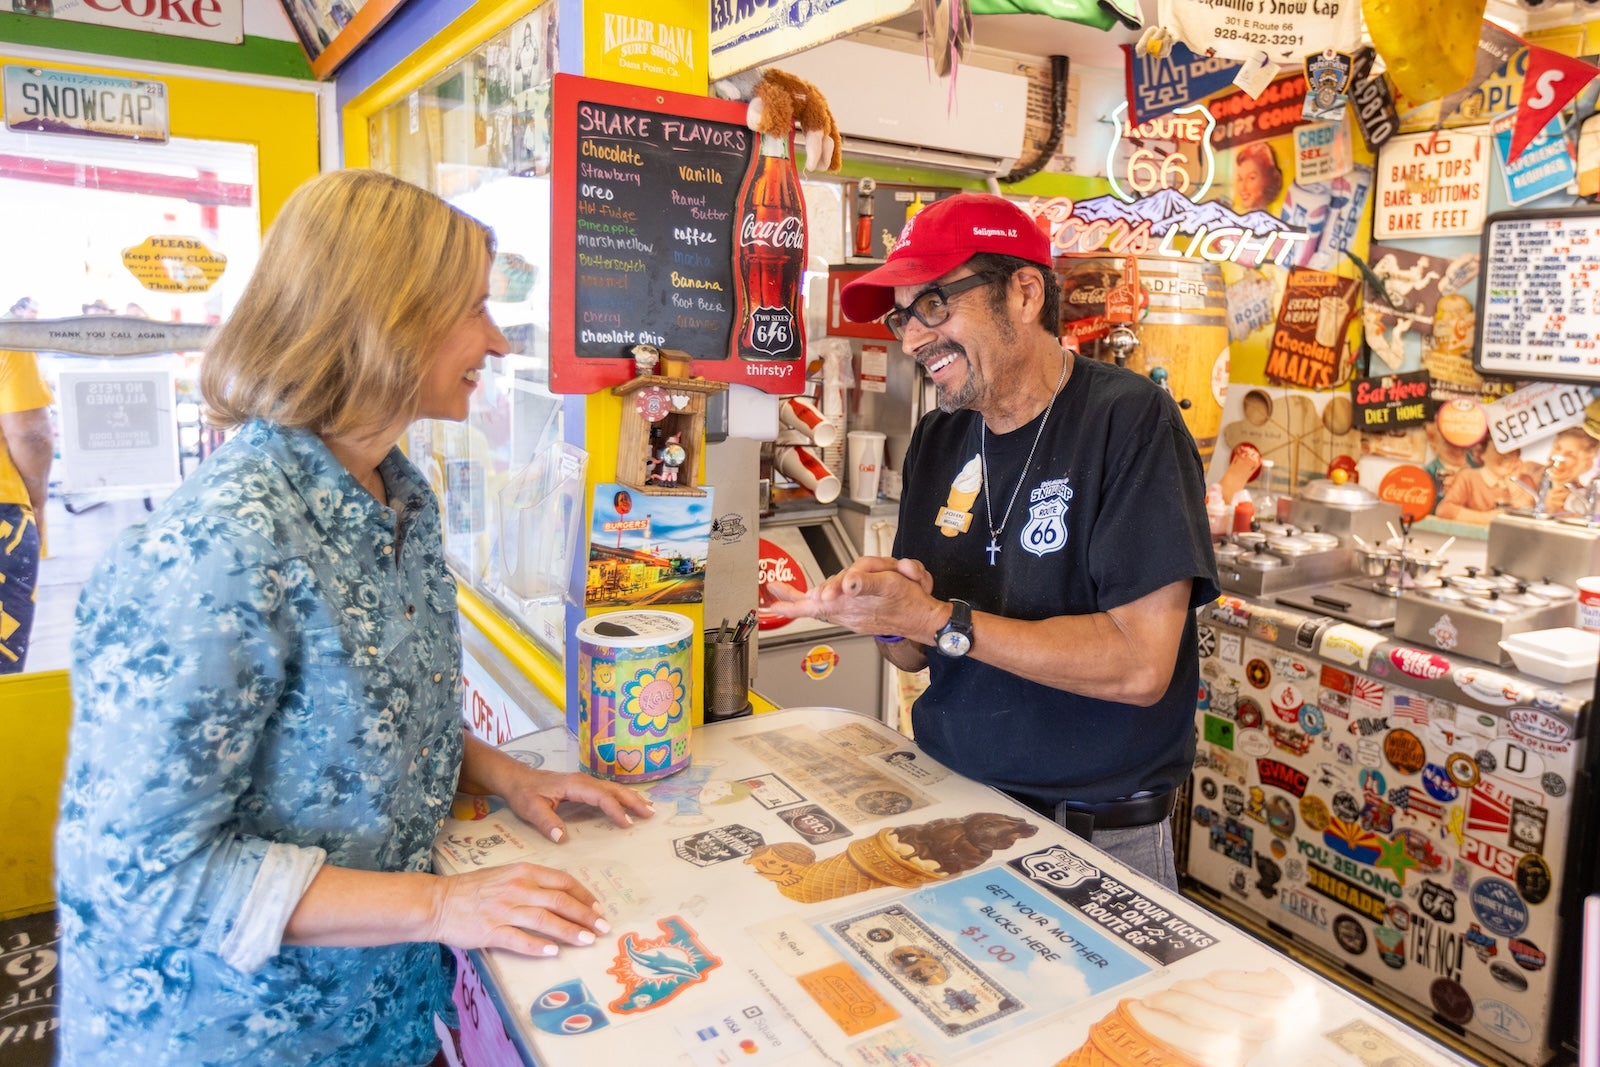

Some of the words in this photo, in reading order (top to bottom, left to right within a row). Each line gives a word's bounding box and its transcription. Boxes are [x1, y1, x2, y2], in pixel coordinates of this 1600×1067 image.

[82, 0, 222, 27] oke
[1225, 16, 1241, 26] 301
[1252, 19, 1280, 31] Route
[1281, 23, 1294, 32] 66
[604, 13, 654, 55] KILLER
[658, 24, 694, 70] DANA
[1214, 27, 1304, 46] 928-422-3291
[618, 58, 641, 70] Dana
[621, 43, 649, 58] SURF
[650, 44, 679, 65] SHOP
[22, 83, 152, 125] SNOWCAP
[580, 106, 651, 137] SHAKE
[661, 121, 746, 151] FLAVORS
[1414, 140, 1451, 157] NO
[581, 162, 641, 186] Strawberry
[1127, 149, 1190, 194] 66
[1391, 163, 1425, 183] BARE
[1436, 159, 1472, 177] TOPS
[671, 189, 707, 207] Peanut
[1384, 187, 1414, 208] BARE
[1421, 183, 1480, 205] BOTTOMS
[690, 207, 729, 221] Butter
[1388, 212, 1423, 231] BARE
[1432, 210, 1468, 229] FEET
[739, 213, 804, 250] Coca-Cola
[1008, 229, 1018, 238] AZ
[152, 238, 201, 250] PLEASE
[1159, 224, 1310, 266] LIGHT
[125, 252, 151, 262] Keep
[578, 252, 648, 273] Butterscotch
[149, 282, 183, 291] Thank
[186, 284, 208, 292] you!
[671, 271, 724, 292] Banana
[1169, 281, 1207, 296] HERE
[672, 293, 694, 309] Root
[1069, 287, 1108, 304] Coca-Col
[771, 314, 789, 322] SIXES
[110, 331, 132, 339] CALL
[1275, 330, 1336, 364] Chocolate
[746, 364, 794, 377] thirsty?
[1266, 349, 1334, 387] MALTS
[1357, 382, 1388, 405] Eat
[1389, 380, 1427, 400] Here
[1365, 407, 1389, 425] DIET
[1397, 404, 1425, 421] HOME
[944, 511, 964, 519] JOHN
[1039, 505, 1057, 516] ROUTE
[604, 519, 647, 530] BURGERS
[1031, 519, 1057, 545] 66
[1396, 648, 1431, 663] road
[1402, 658, 1445, 678] sister
[801, 814, 829, 834] 1313
[1055, 861, 1070, 871] US
[1058, 853, 1090, 874] ROUTE
[1295, 836, 1328, 865] YOU
[1333, 855, 1403, 898] BELONG
[1461, 838, 1516, 876] PUS
[1033, 861, 1069, 882] 66
[985, 884, 1014, 902] GET
[1012, 900, 1049, 927] YOUR
[1049, 927, 1109, 969] MOTHER
[1080, 902, 1125, 935] ROUTE
[1125, 909, 1149, 927] ON
[1128, 894, 1168, 923] YOUR
[1163, 917, 1213, 948] KICKS
[960, 925, 1016, 963] $1.00
[979, 905, 1022, 936] BUCKS
[1021, 935, 1062, 962] HERE
[722, 1015, 741, 1034] VISA
